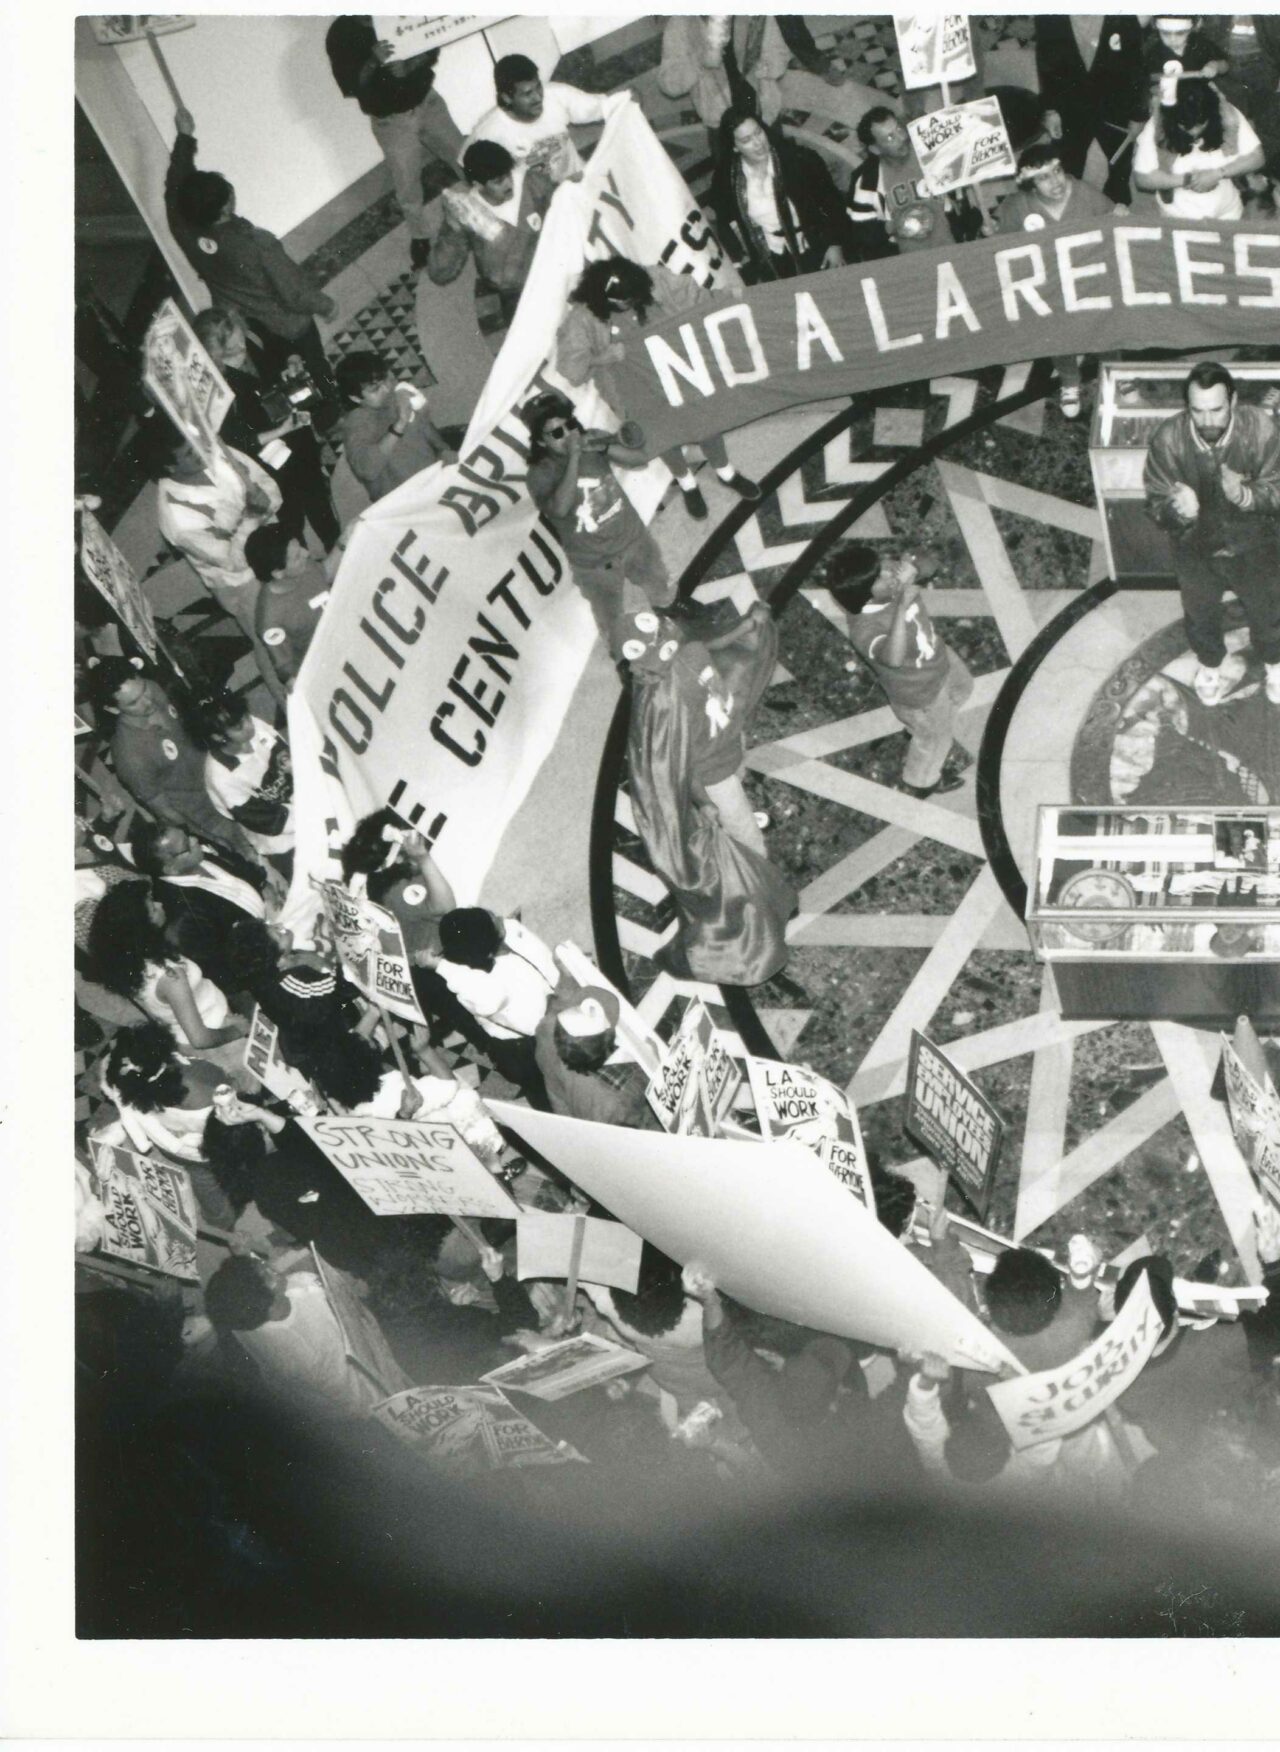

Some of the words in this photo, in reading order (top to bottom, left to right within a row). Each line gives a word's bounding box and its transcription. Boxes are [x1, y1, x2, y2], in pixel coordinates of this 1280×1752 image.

[916, 116, 940, 137] LA
[923, 123, 964, 152] WORK
[973, 131, 1002, 151] FOR
[645, 302, 769, 407] NO
[796, 292, 843, 370] A
[860, 262, 982, 352] LA
[376, 956, 404, 979] FOR
[376, 971, 414, 996] EVERYONE
[765, 1069, 794, 1087] LA
[919, 1045, 996, 1137] SERVICE
[770, 1086, 818, 1099] SHOULD
[774, 1099, 820, 1120] WORK
[313, 1121, 456, 1150] STRONG
[915, 1077, 989, 1176] UNION
[332, 1150, 455, 1174] UNIONS
[830, 1144, 857, 1169] FOR
[104, 1213, 122, 1249] LA
[121, 1192, 146, 1250] WORK
[387, 1394, 422, 1422] LA
[399, 1394, 456, 1427] SHOULD
[408, 1403, 464, 1437] WORK
[493, 1422, 529, 1437] FOR
